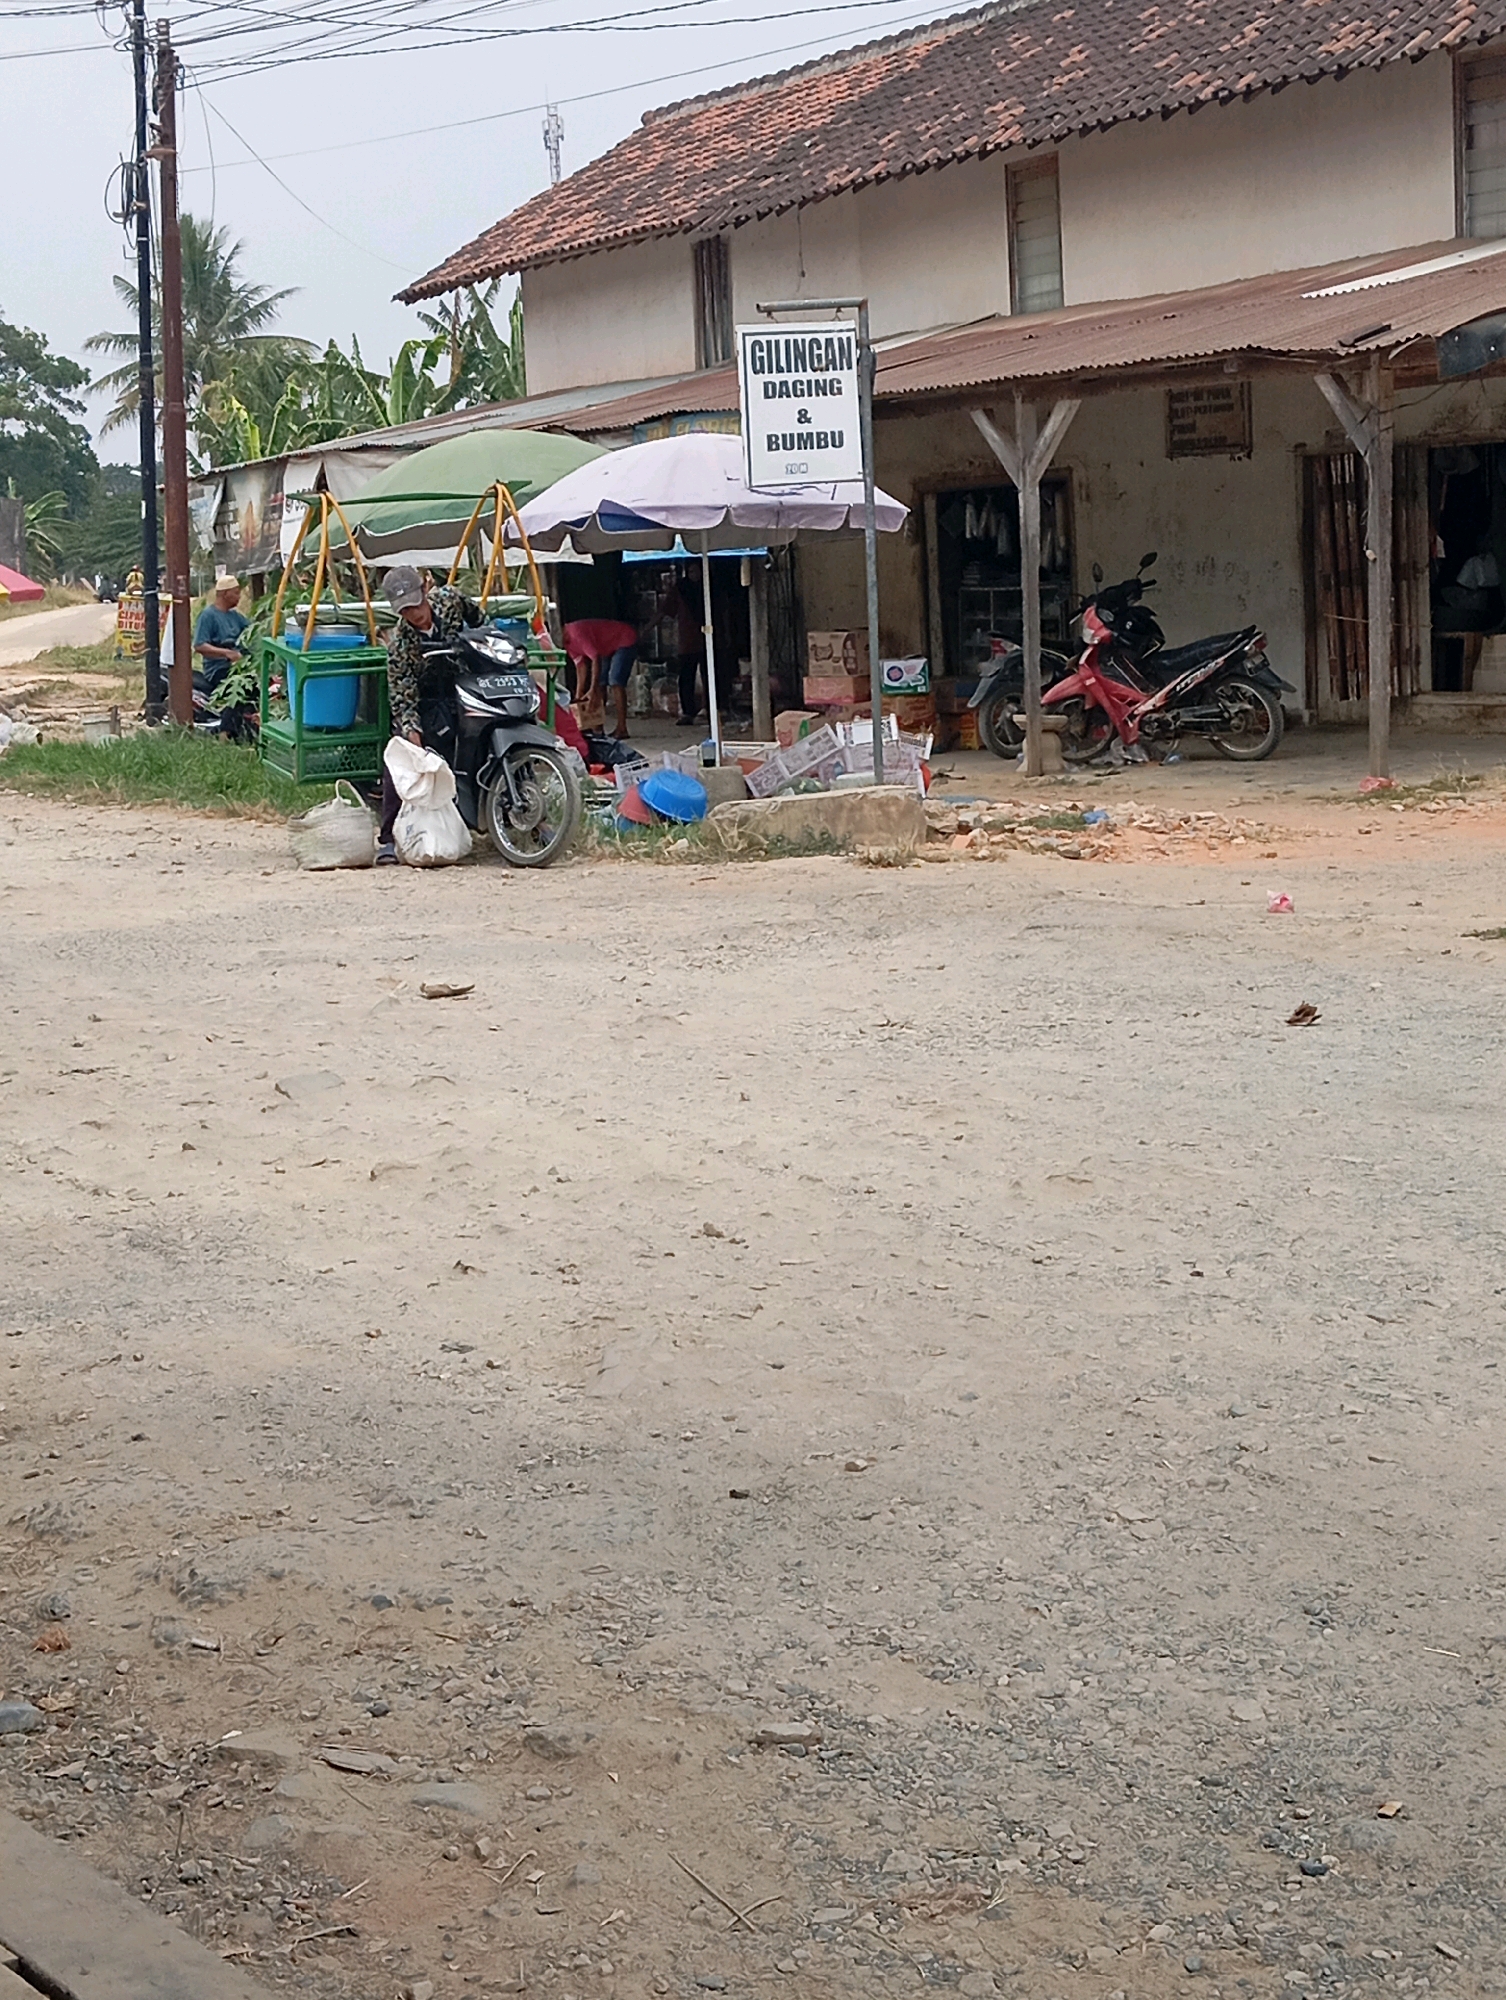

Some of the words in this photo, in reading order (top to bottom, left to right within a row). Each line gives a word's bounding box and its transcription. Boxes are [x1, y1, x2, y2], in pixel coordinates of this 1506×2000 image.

[751, 336, 853, 375] GILINGAN
[763, 377, 843, 400] DAGING
[797, 408, 812, 424] &
[766, 430, 844, 452] BUMBU
